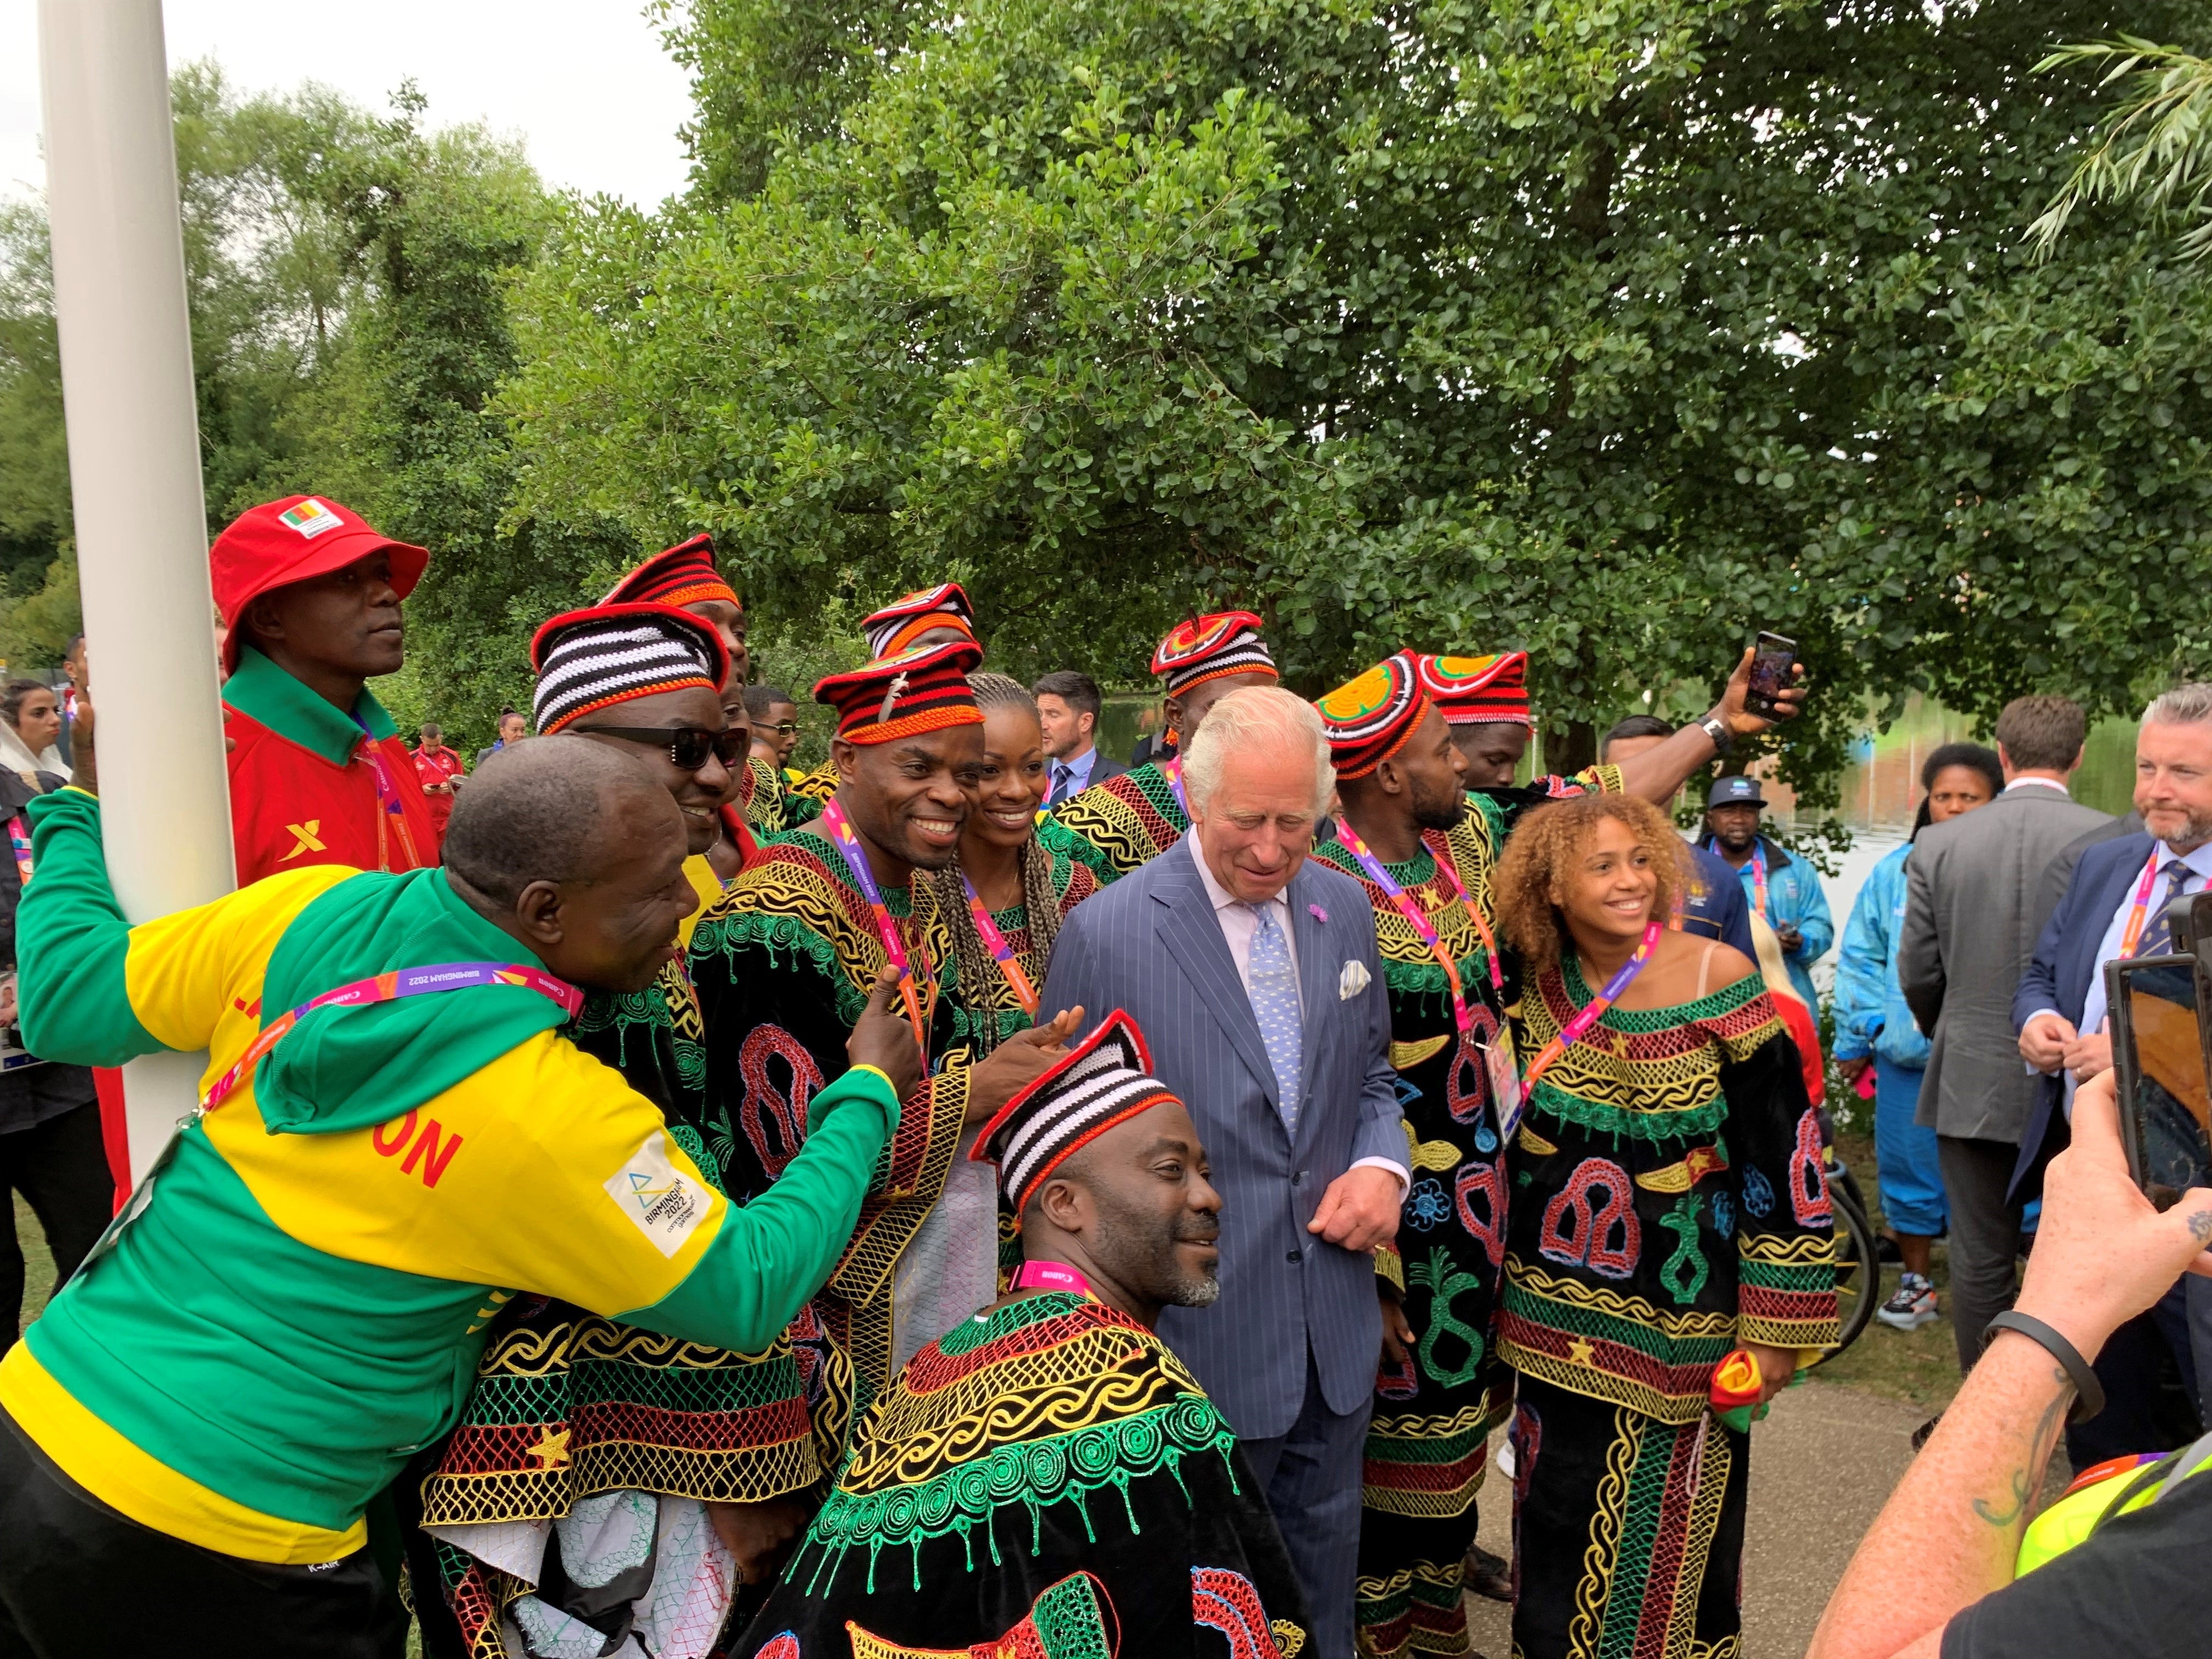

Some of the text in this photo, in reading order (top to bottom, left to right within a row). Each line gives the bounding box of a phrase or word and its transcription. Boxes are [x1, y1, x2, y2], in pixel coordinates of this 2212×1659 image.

[851, 853, 875, 897] BIRMINGHAM 2022
[981, 919, 997, 942] Canon
[885, 928, 899, 955] Canon
[408, 970, 479, 986] BIRMINGHAM 2022
[538, 978, 565, 997] Canon
[664, 1196, 687, 1219] 2022
[678, 1211, 695, 1228] games
[1041, 1271, 1074, 1283] Canon
